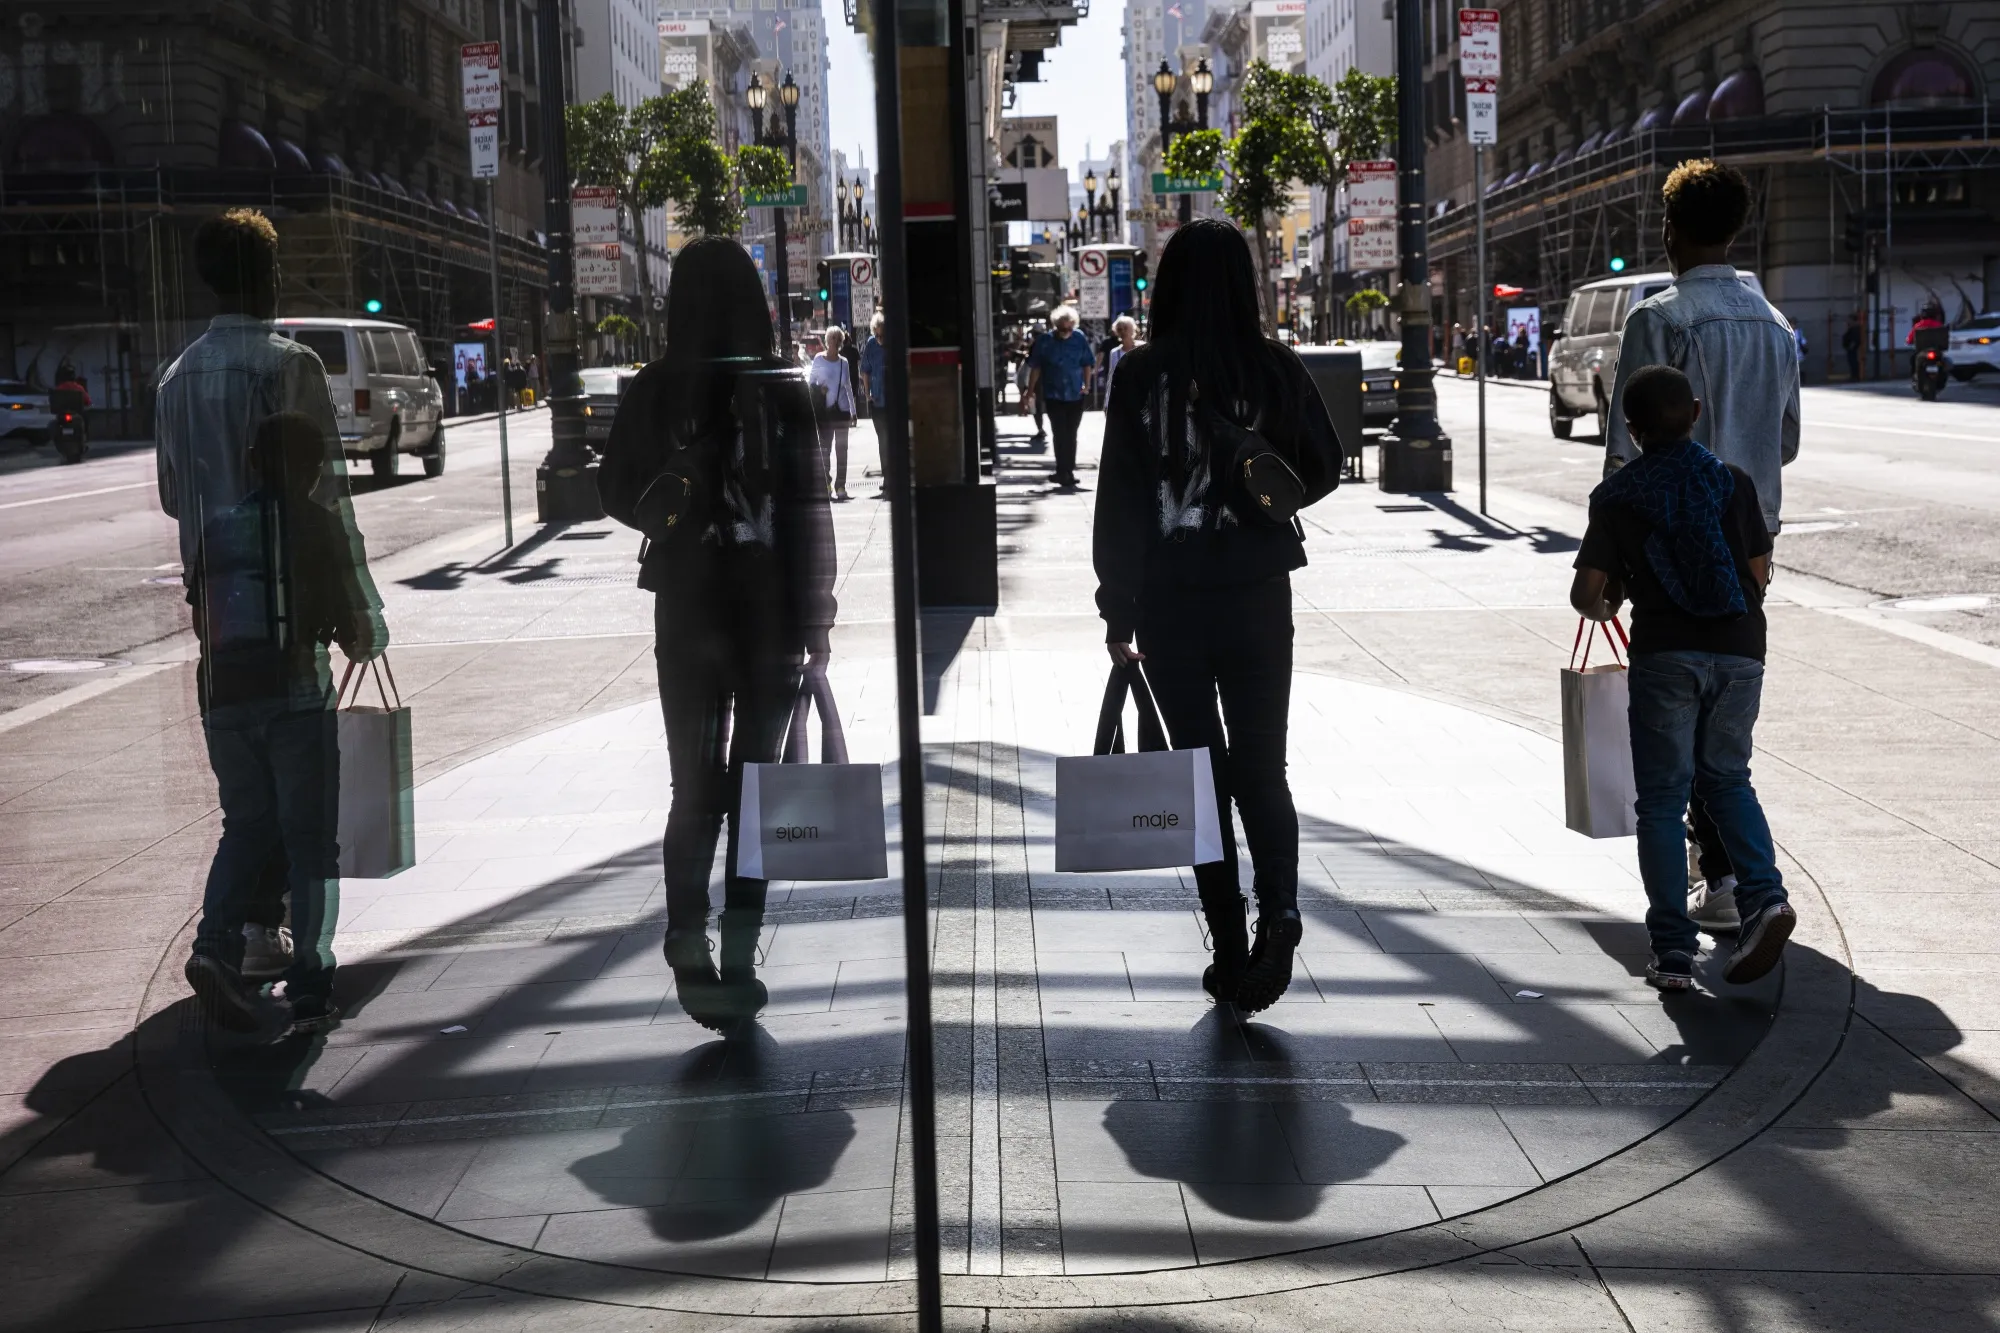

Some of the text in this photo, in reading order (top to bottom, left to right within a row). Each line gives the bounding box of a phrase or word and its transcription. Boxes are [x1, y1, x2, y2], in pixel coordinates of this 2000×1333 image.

[1134, 8, 1146, 140] HOTEL ADAGIO
[1132, 810, 1178, 830] maje
